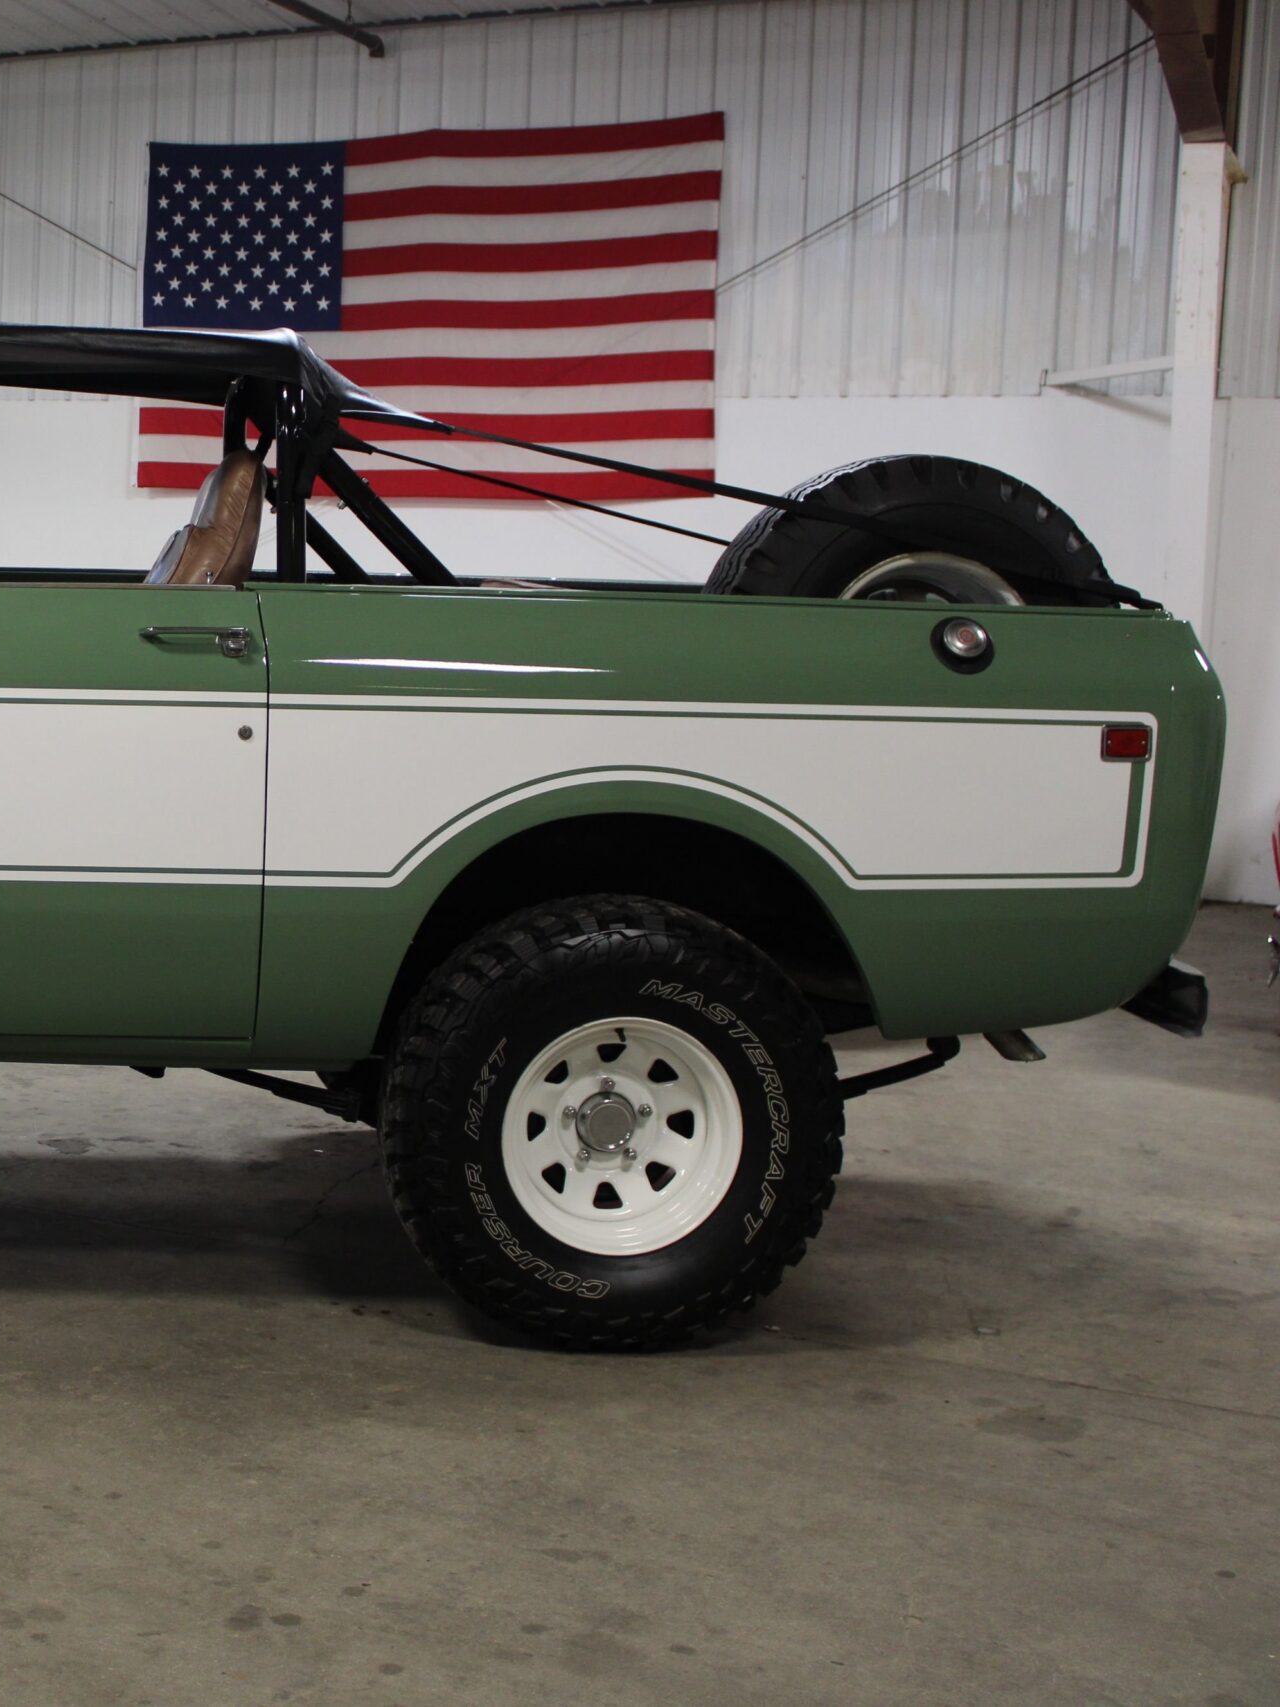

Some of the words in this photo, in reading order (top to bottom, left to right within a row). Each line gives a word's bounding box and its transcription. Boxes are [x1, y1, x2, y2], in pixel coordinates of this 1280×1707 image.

[464, 1037, 508, 1141] MXT
[638, 978, 790, 1245] MASTERCRAFT
[464, 1162, 611, 1300] COURSER
